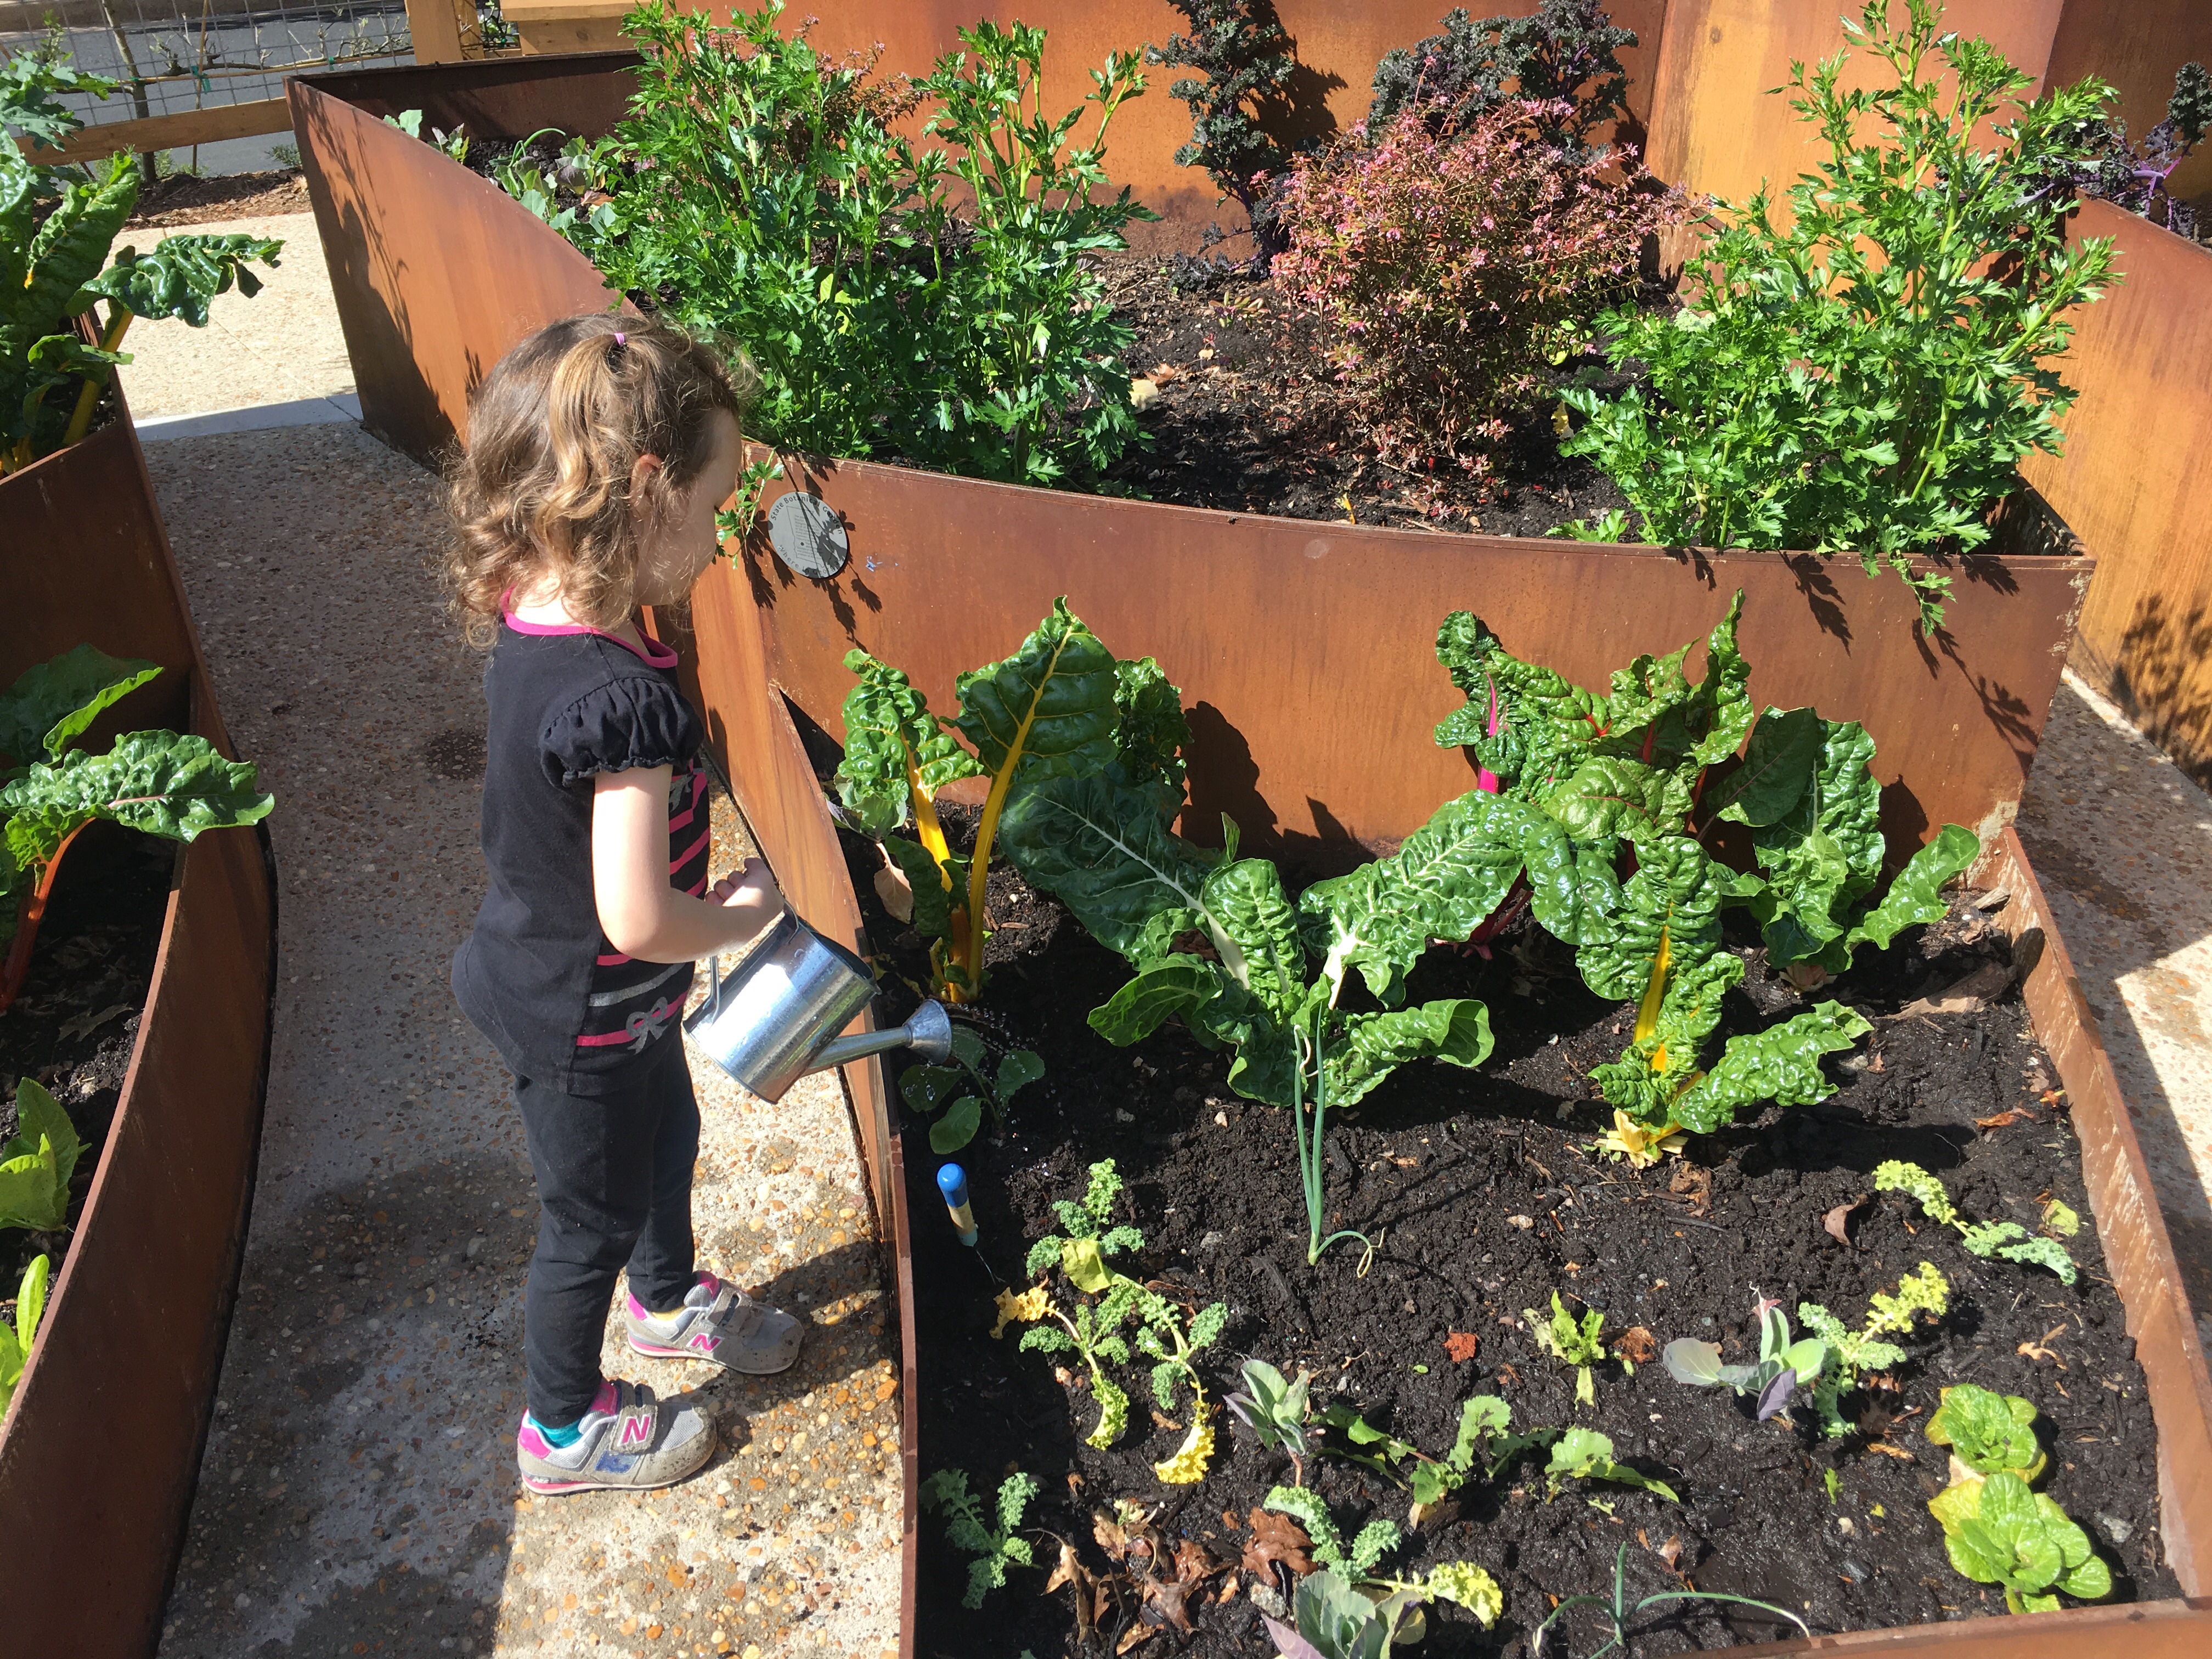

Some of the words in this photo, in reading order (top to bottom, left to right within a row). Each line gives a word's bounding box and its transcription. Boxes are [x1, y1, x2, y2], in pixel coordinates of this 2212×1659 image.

[771, 502, 784, 521] State
[783, 495, 820, 507] Botanical
[823, 506, 842, 534] Garden
[777, 545, 799, 568] Where
[812, 561, 839, 575] Geoga
[686, 1333, 725, 1352] N
[617, 1414, 652, 1447] N
